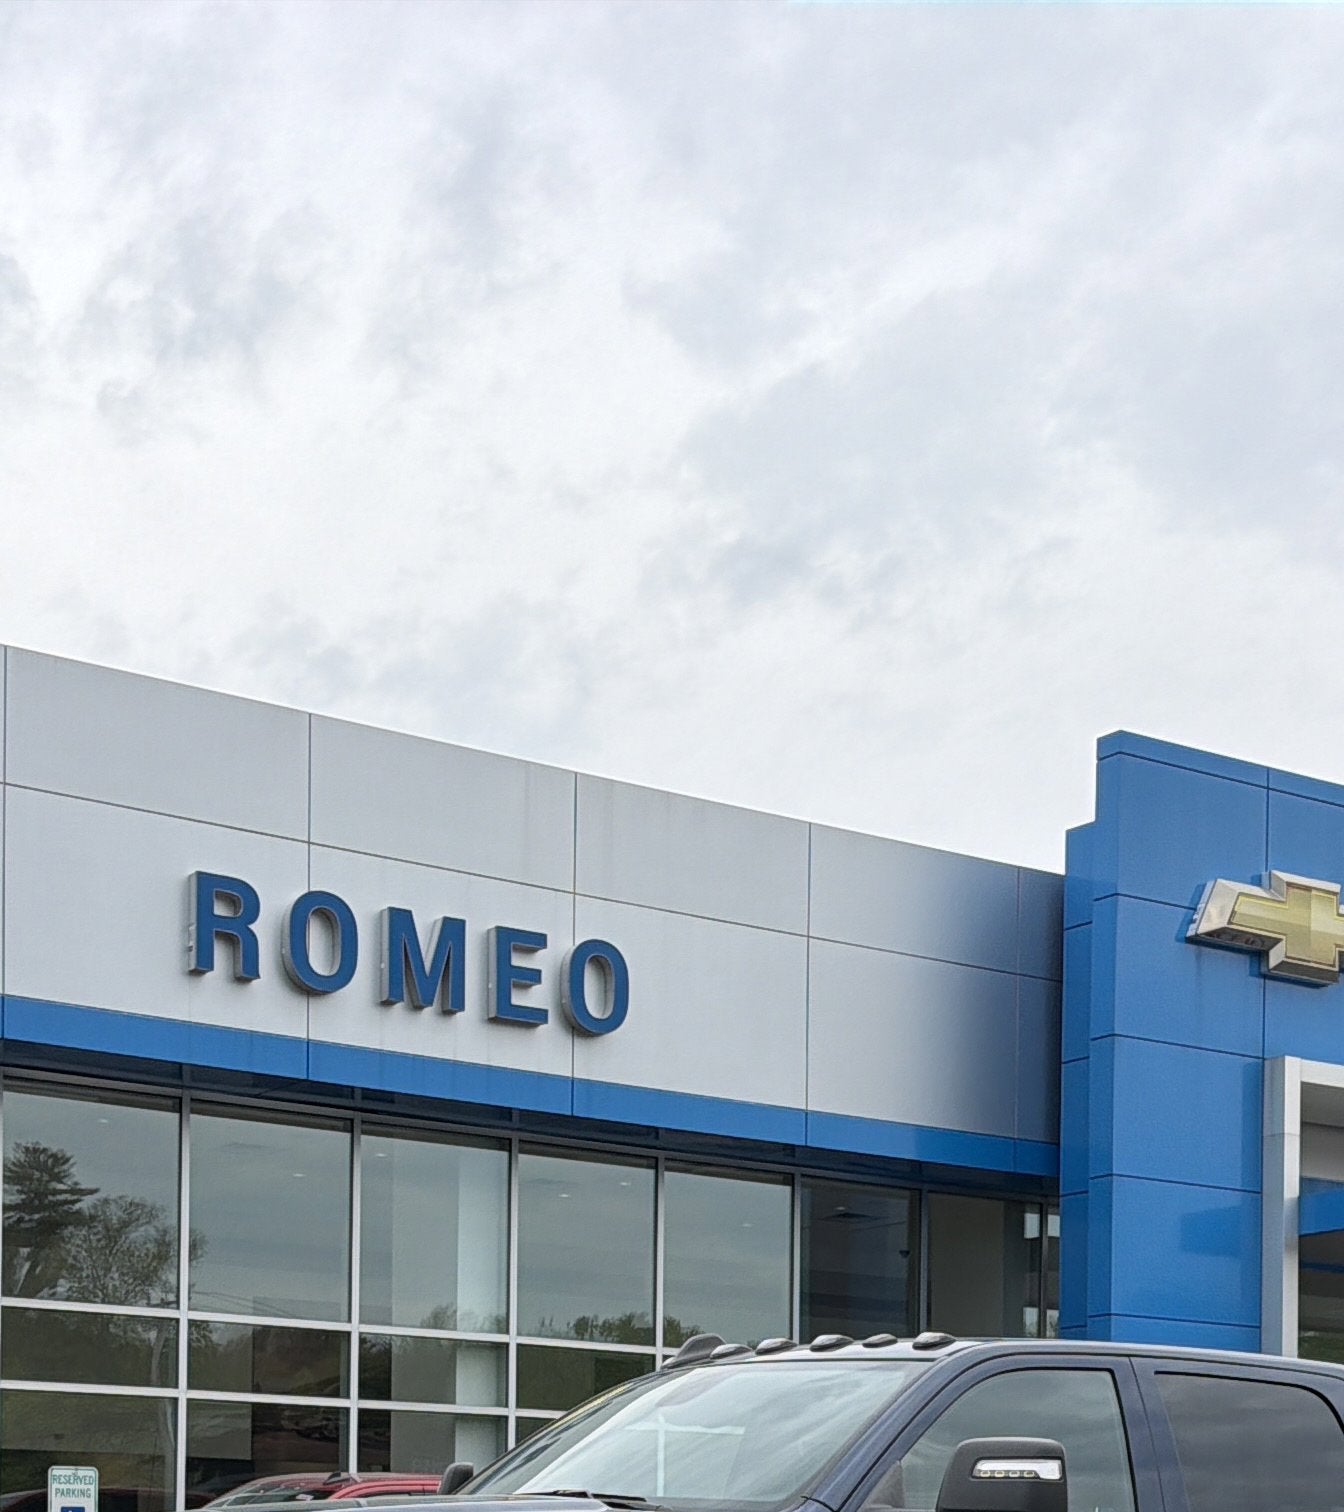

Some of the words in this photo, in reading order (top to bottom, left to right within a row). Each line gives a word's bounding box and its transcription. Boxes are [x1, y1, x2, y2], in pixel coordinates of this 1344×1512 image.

[187, 869, 630, 1037] ROMEO
[52, 1475, 95, 1486] RESERVED
[55, 1487, 92, 1499] PARKING
